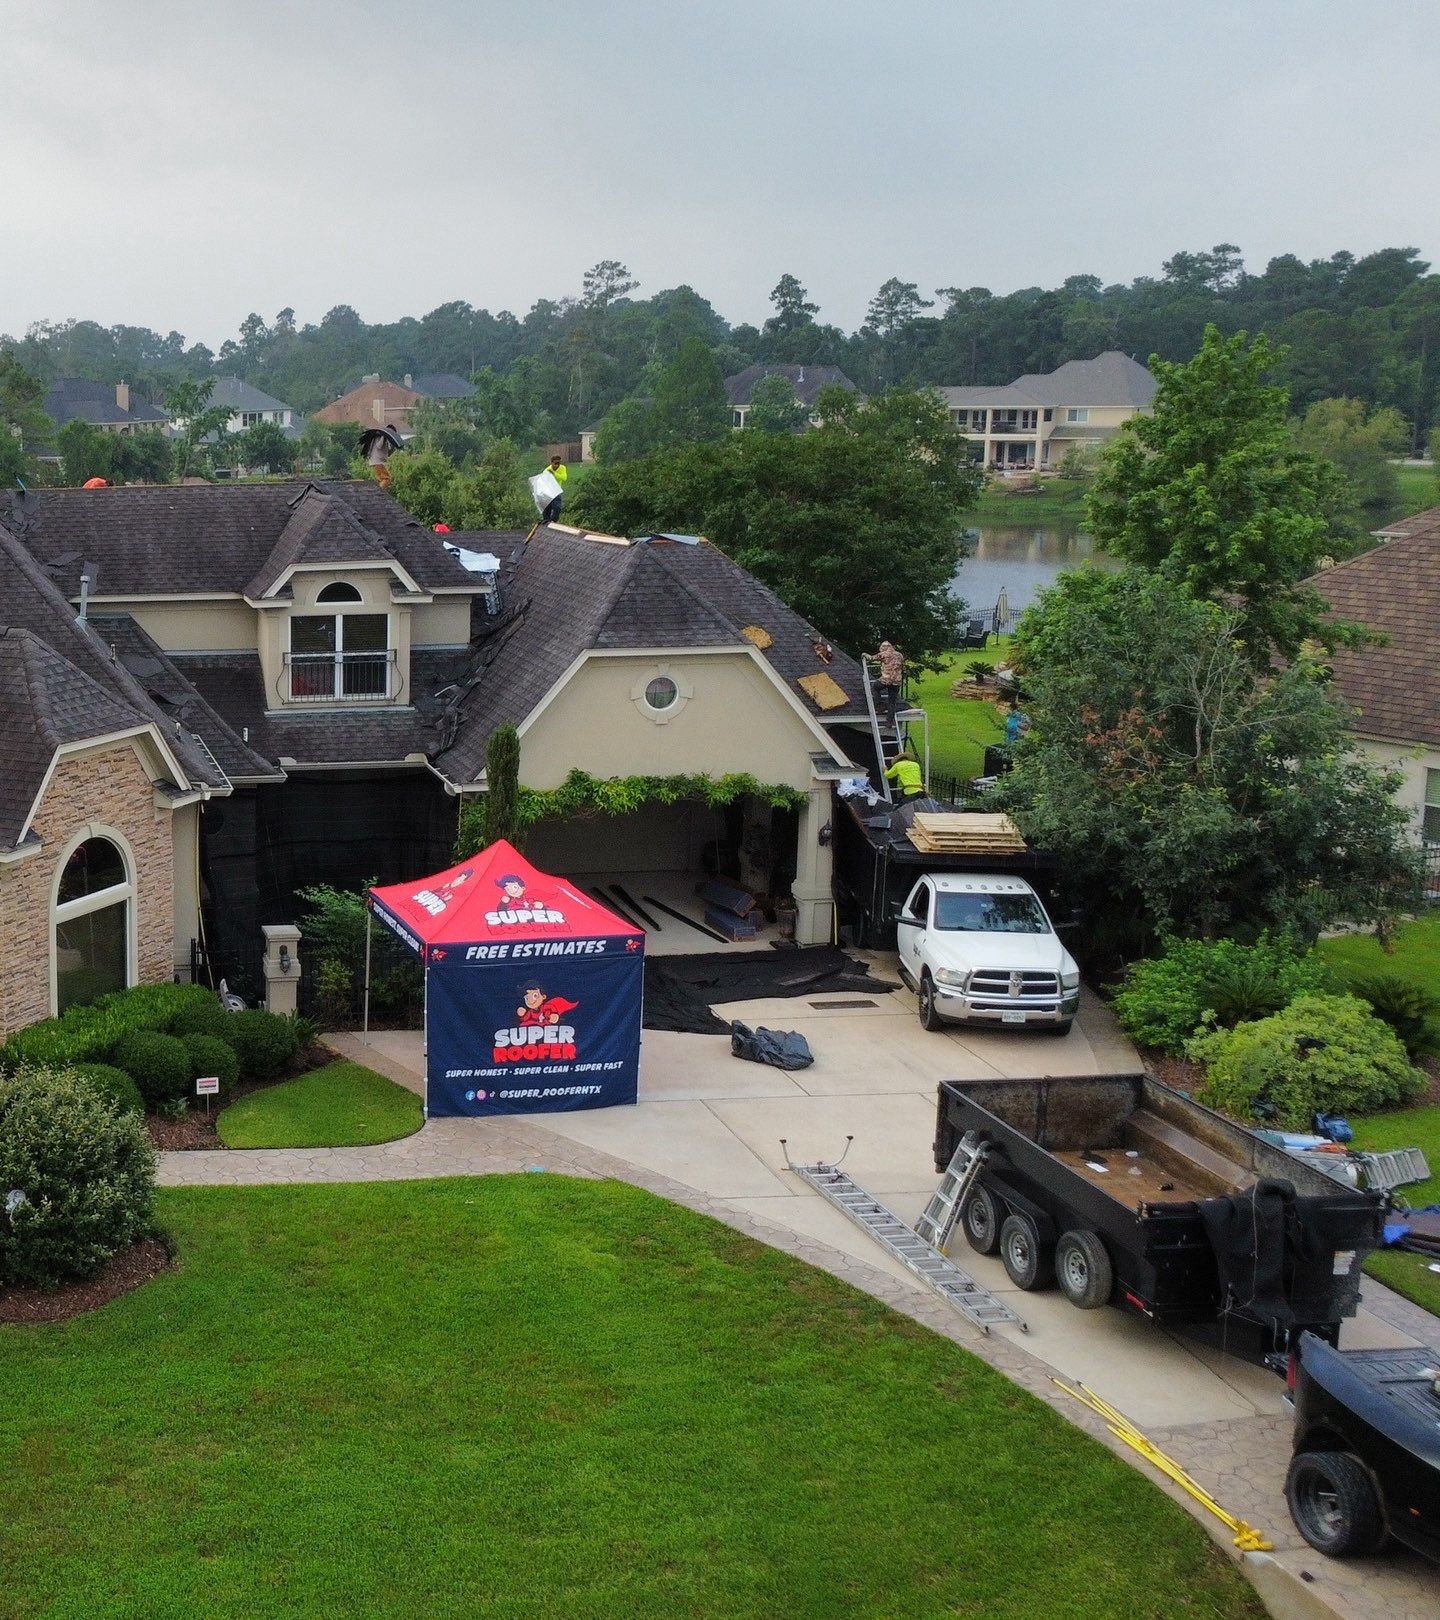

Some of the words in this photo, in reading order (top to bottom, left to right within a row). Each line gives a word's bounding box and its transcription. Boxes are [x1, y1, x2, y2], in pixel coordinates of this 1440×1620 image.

[484, 909, 566, 925] SUPER
[465, 944, 510, 960] FREE
[511, 939, 607, 958] ESTIMATES
[494, 1025, 576, 1048] SUPER
[493, 1043, 577, 1063] ROOFER
[445, 1069, 473, 1078] SUPER
[473, 1068, 509, 1077] HONEST
[513, 1066, 542, 1075] SUPER
[542, 1064, 570, 1074] CLEAN
[574, 1062, 603, 1072] SUPER
[603, 1060, 624, 1070] FAST
[499, 1085, 602, 1099] @SUPER_ROOFERHTX
